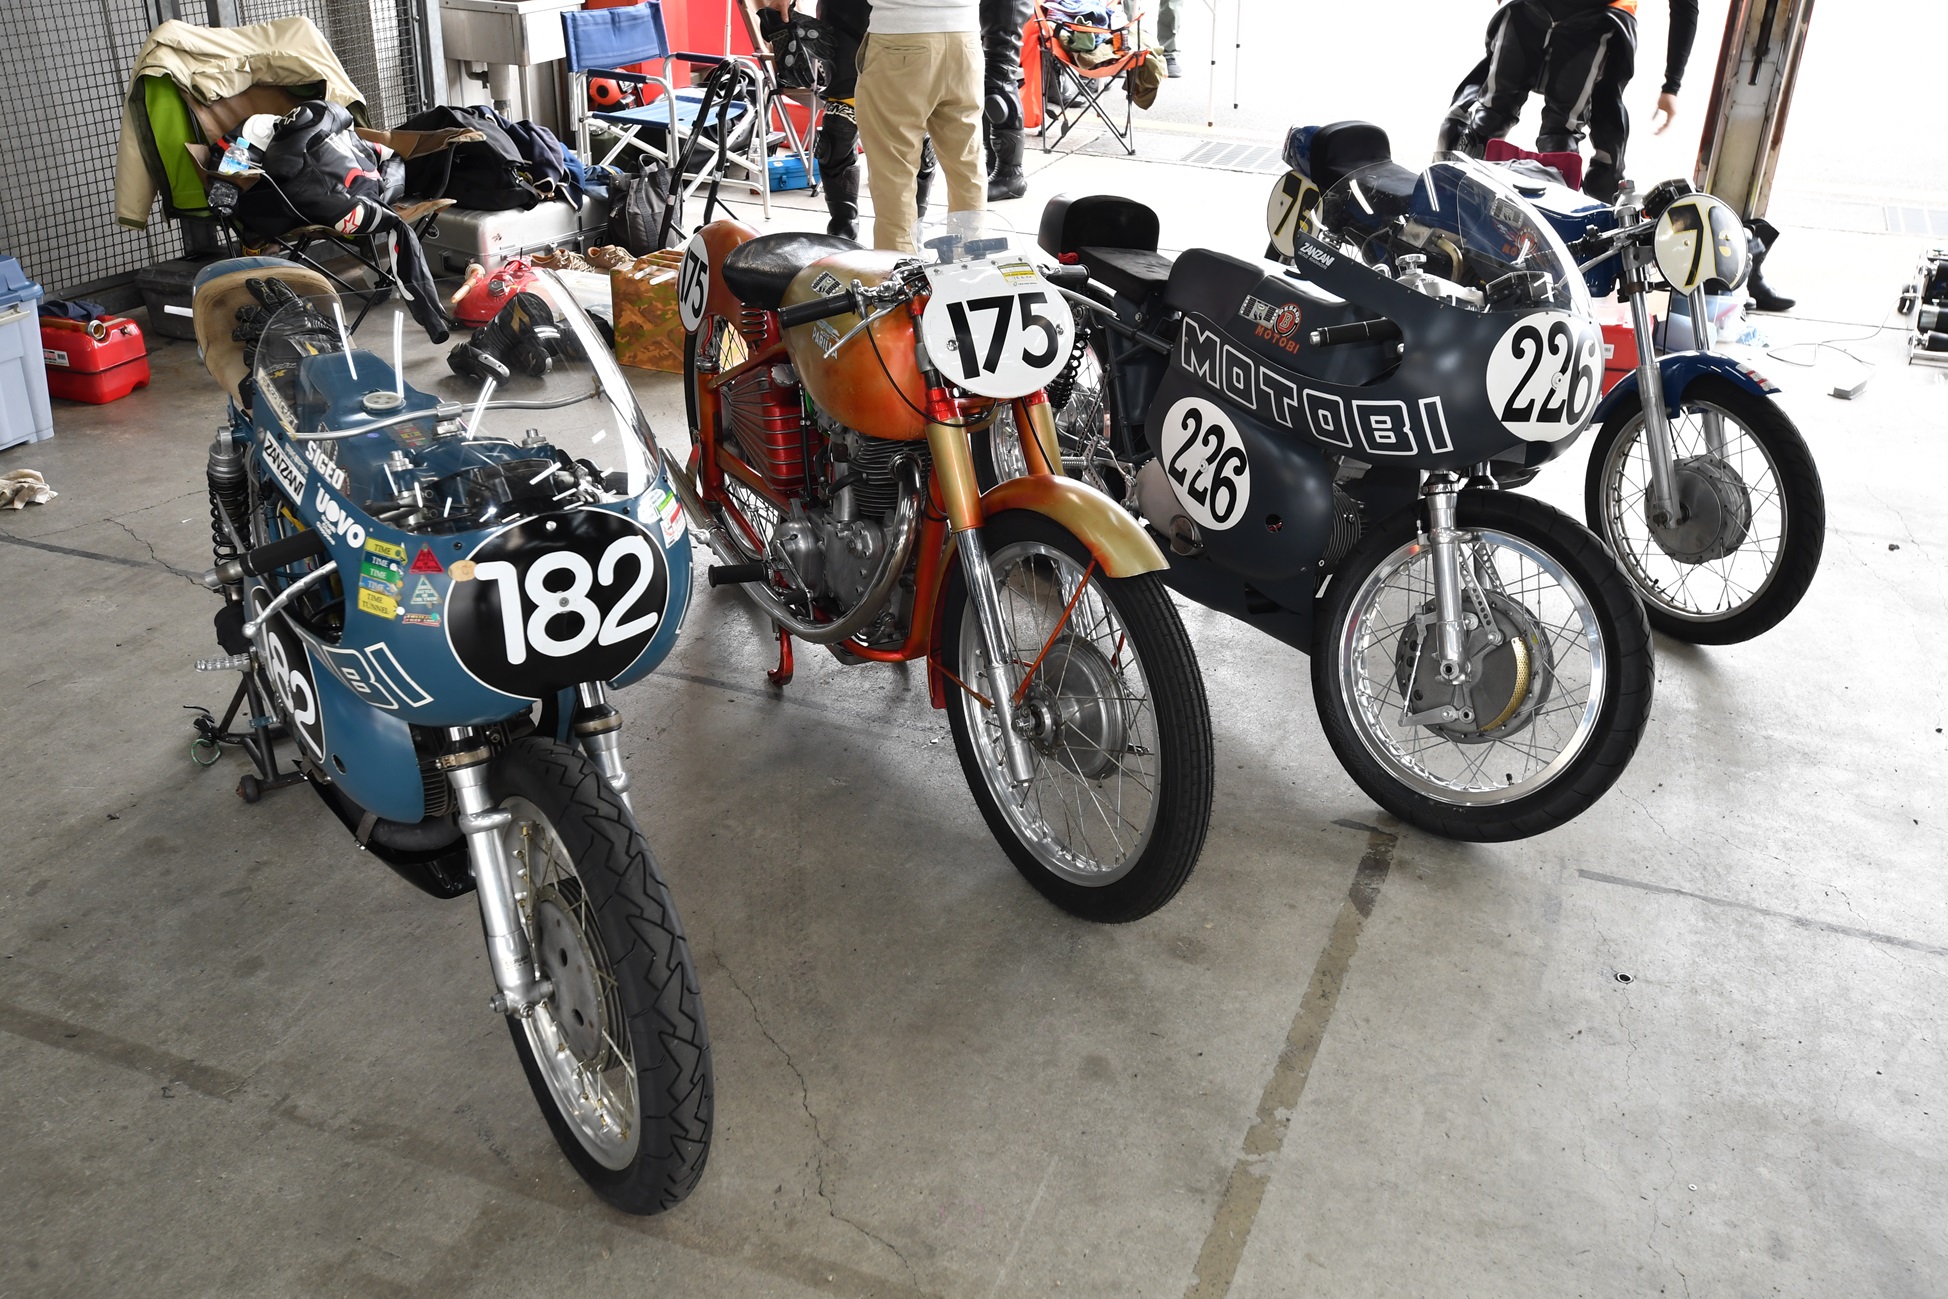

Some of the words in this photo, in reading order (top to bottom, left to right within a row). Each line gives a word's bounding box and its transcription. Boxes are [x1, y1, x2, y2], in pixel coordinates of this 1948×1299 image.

[1300, 242, 1335, 267] ZANZANI
[680, 246, 708, 319] 175
[946, 292, 1059, 380] 175
[1254, 325, 1300, 354] MOTOBI
[1181, 316, 1454, 456] MOTOBI
[1501, 320, 1595, 425] 226
[263, 438, 305, 497] ZANZANI
[1168, 407, 1247, 524] 226
[371, 556, 389, 568] TIME
[373, 543, 391, 555] TIME
[369, 568, 387, 579] TIME
[361, 601, 389, 614] TUNNEL
[366, 592, 383, 603] TIME
[474, 535, 659, 665] 182
